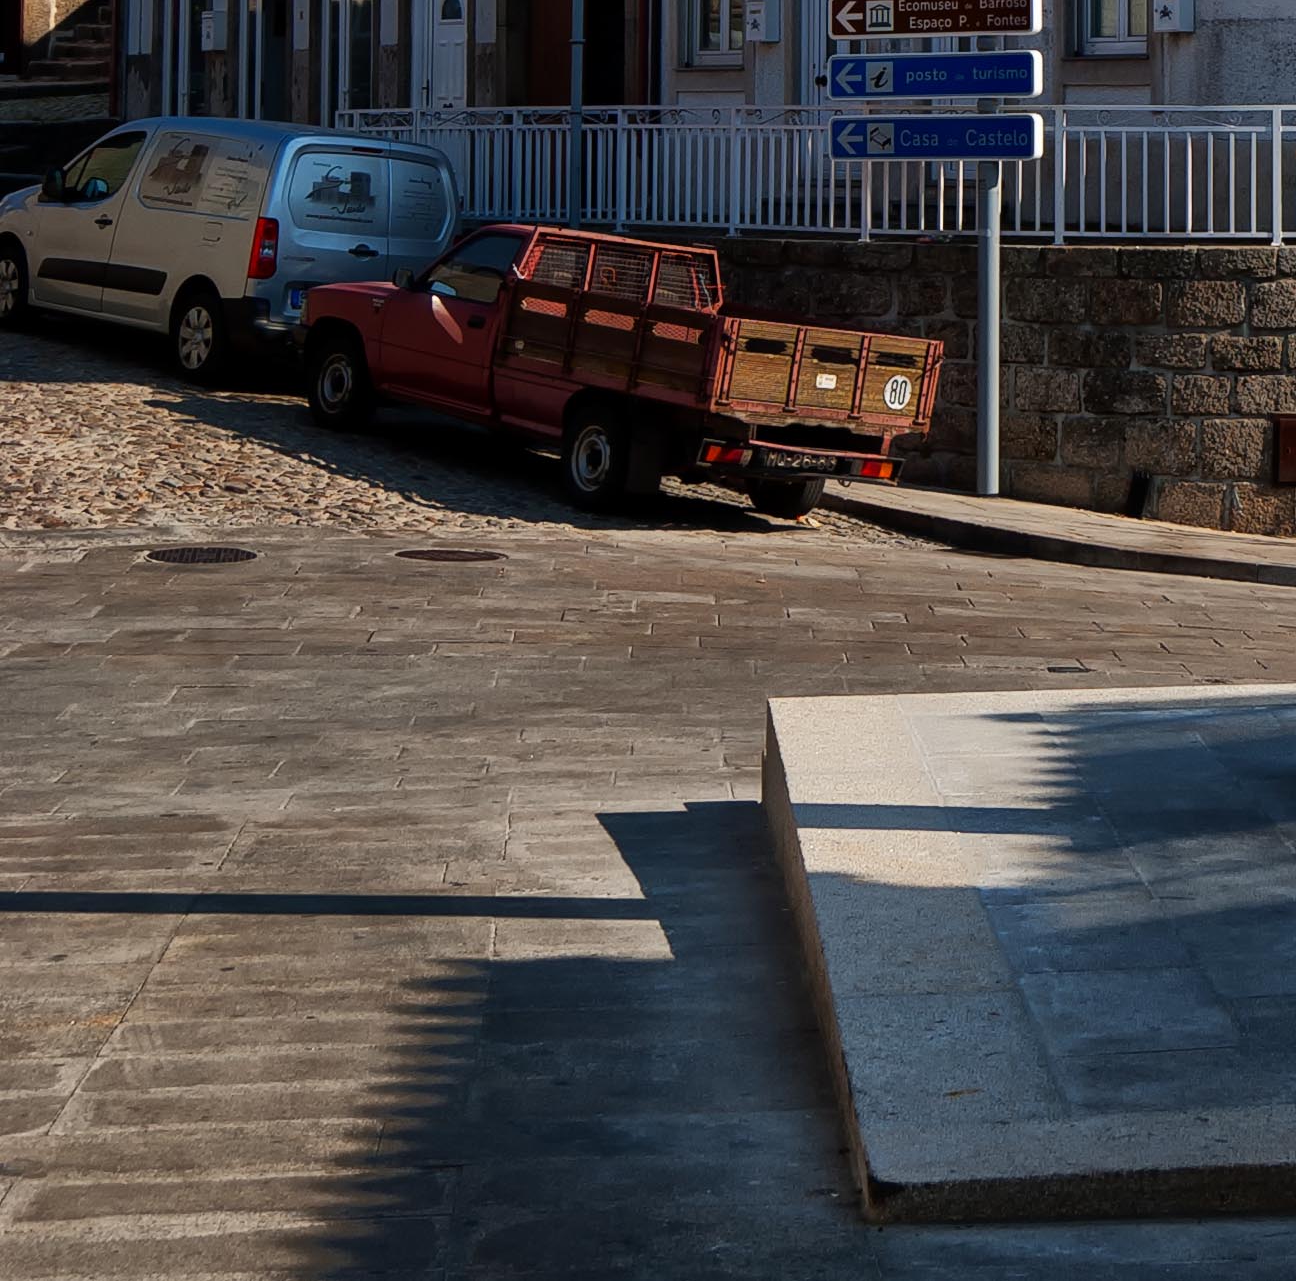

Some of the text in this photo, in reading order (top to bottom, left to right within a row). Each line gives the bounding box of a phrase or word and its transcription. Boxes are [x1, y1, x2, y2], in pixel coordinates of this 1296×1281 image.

[898, 0, 959, 12] Ecomuseu
[909, 16, 952, 30] Espaço
[987, 14, 1028, 27] Fontes
[906, 68, 948, 84] posto
[972, 65, 1028, 80] turismo
[900, 129, 939, 147] Casa
[965, 128, 1028, 146] Castelo
[889, 379, 908, 405] 80
